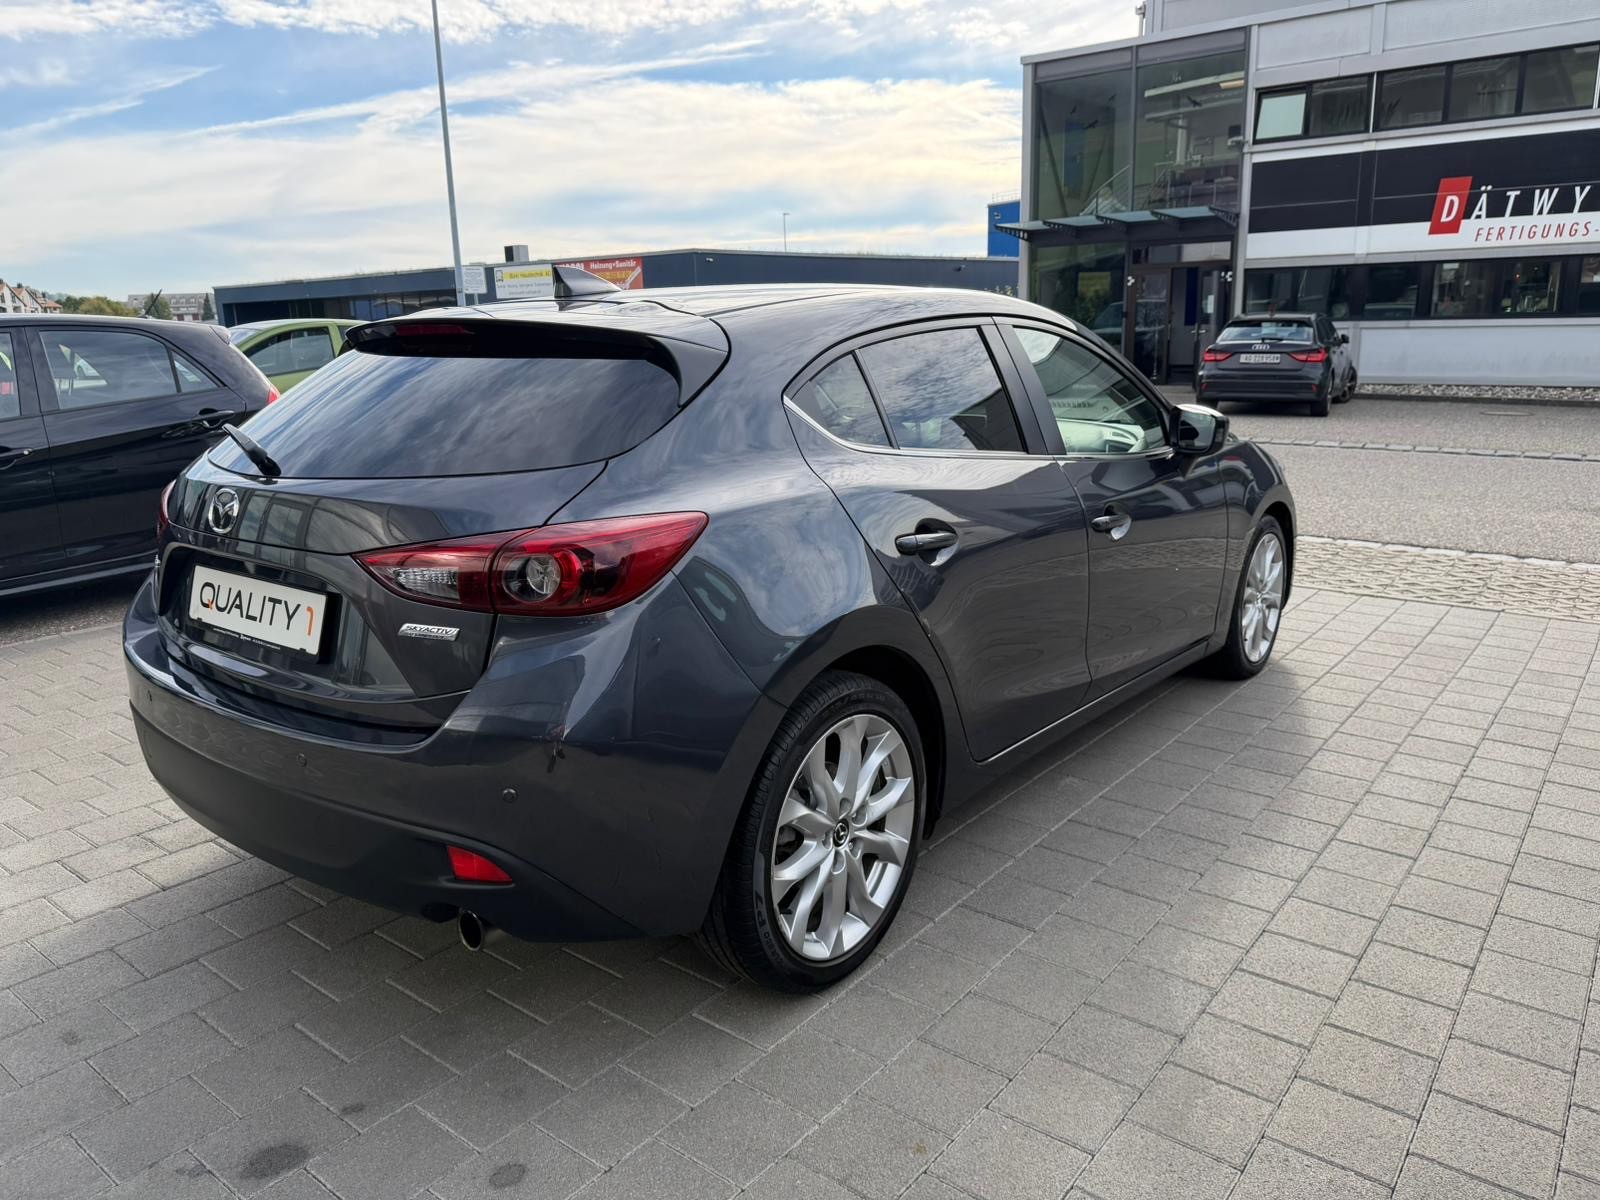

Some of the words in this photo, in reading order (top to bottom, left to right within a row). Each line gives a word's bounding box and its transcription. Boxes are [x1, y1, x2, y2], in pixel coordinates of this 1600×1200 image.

[1440, 184, 1592, 222] DÄTWY
[200, 581, 301, 631] QUALITY
[306, 606, 314, 636] 1
[406, 625, 452, 635] SKYACTIV
